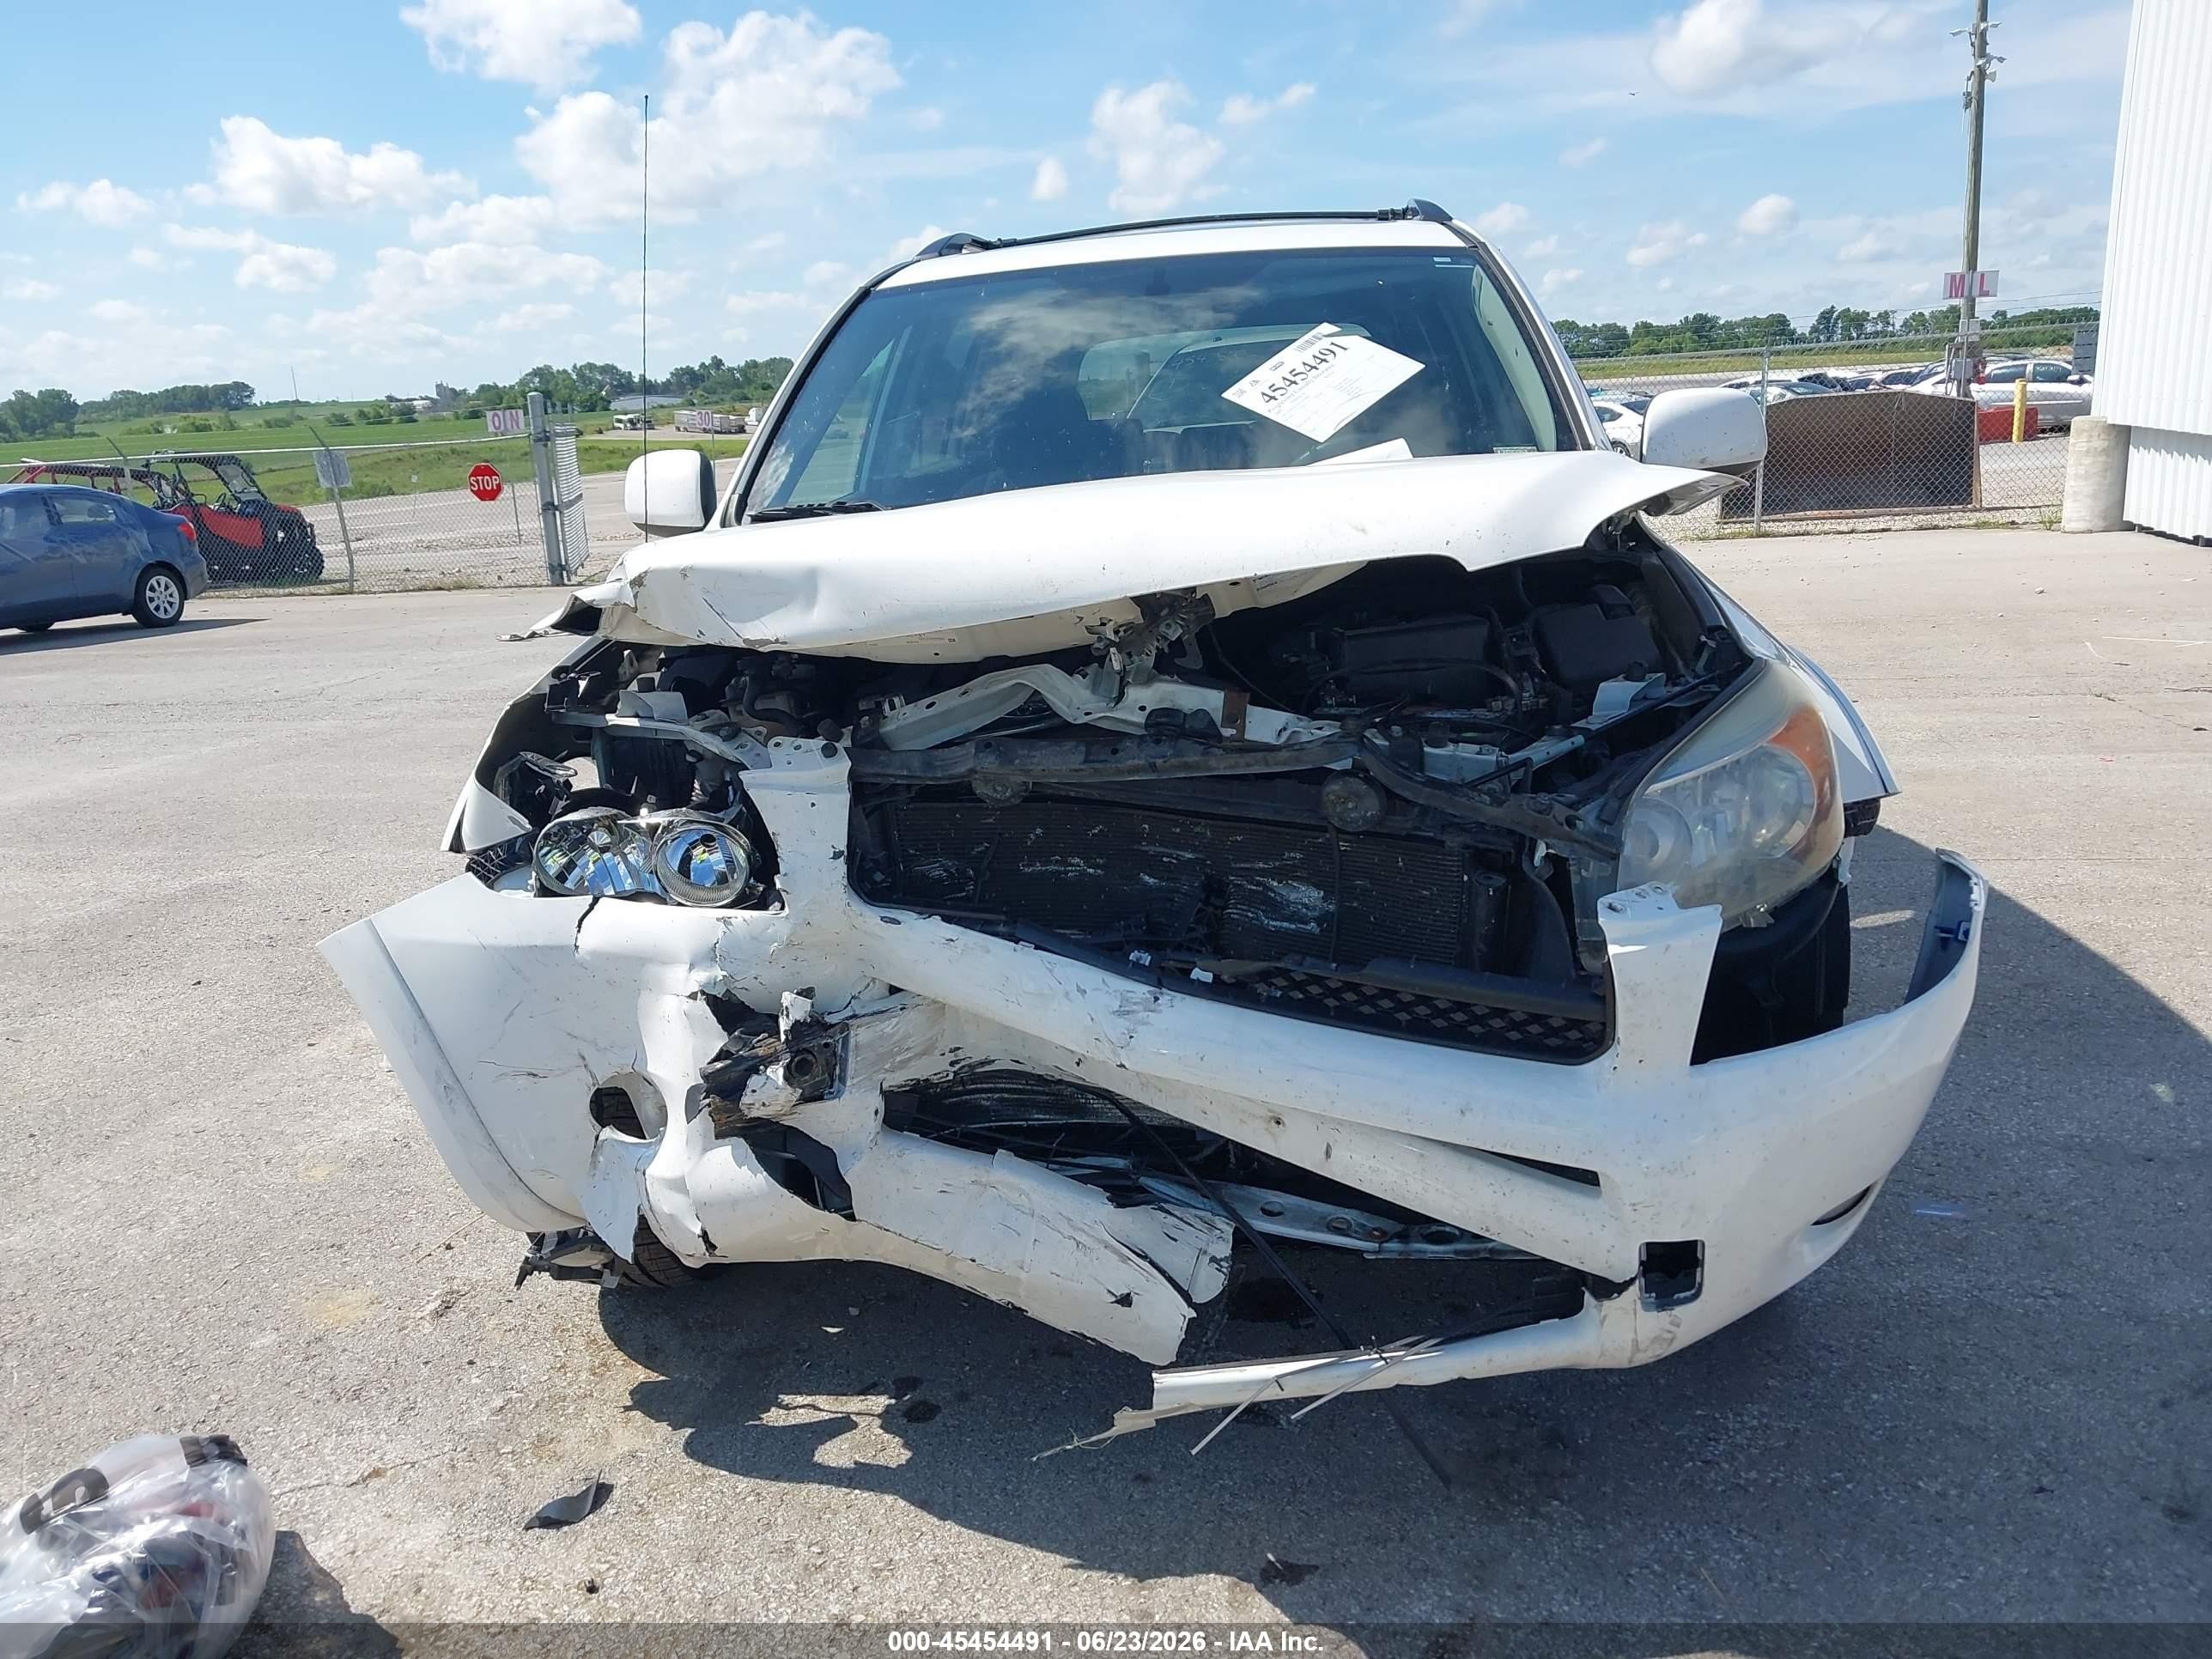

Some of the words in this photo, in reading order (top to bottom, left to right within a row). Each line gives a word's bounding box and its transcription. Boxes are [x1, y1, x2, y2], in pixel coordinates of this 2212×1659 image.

[1949, 275, 1966, 298] M
[1978, 273, 1990, 296] L
[1261, 342, 1349, 404] 45454491
[696, 410, 711, 428] 30
[471, 476, 500, 491] STOP
